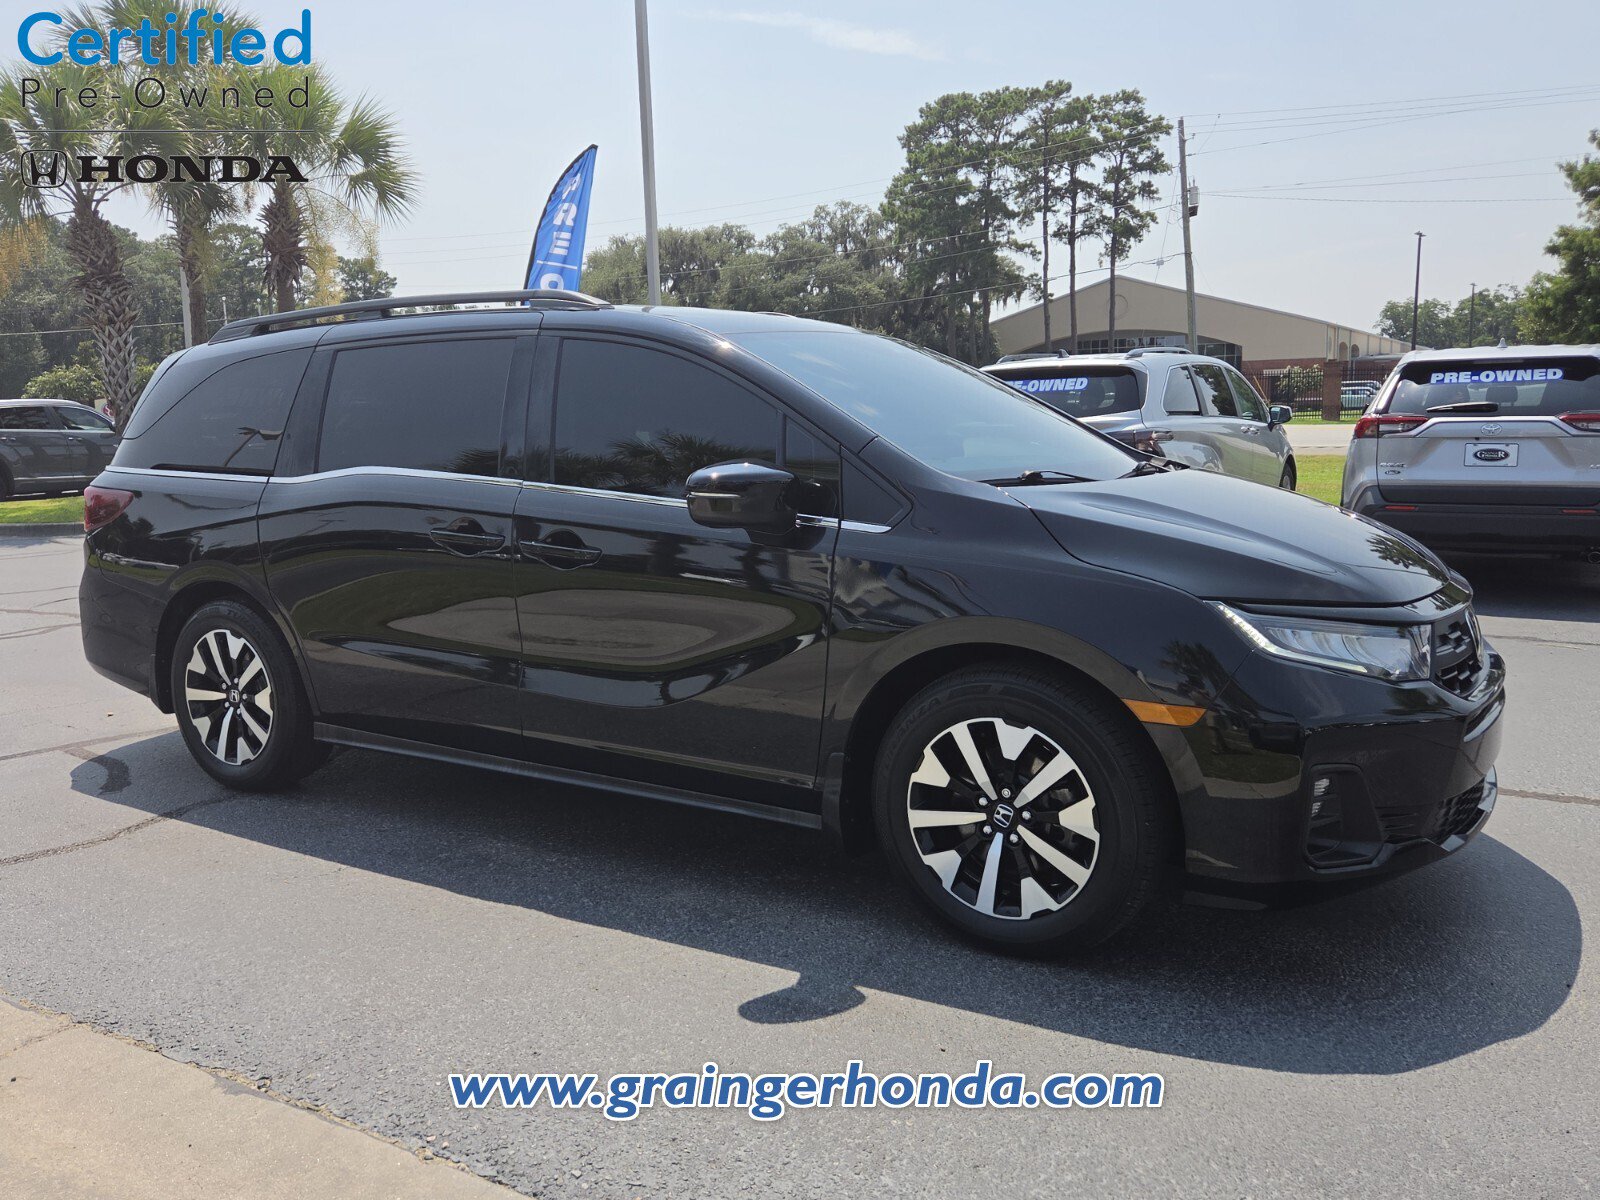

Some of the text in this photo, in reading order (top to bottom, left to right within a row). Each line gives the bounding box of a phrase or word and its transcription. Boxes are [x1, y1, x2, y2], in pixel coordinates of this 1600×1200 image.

[537, 173, 582, 291] PRE-O
[1430, 368, 1563, 384] PRE-OWNED
[1005, 377, 1088, 392] E-OWNED
